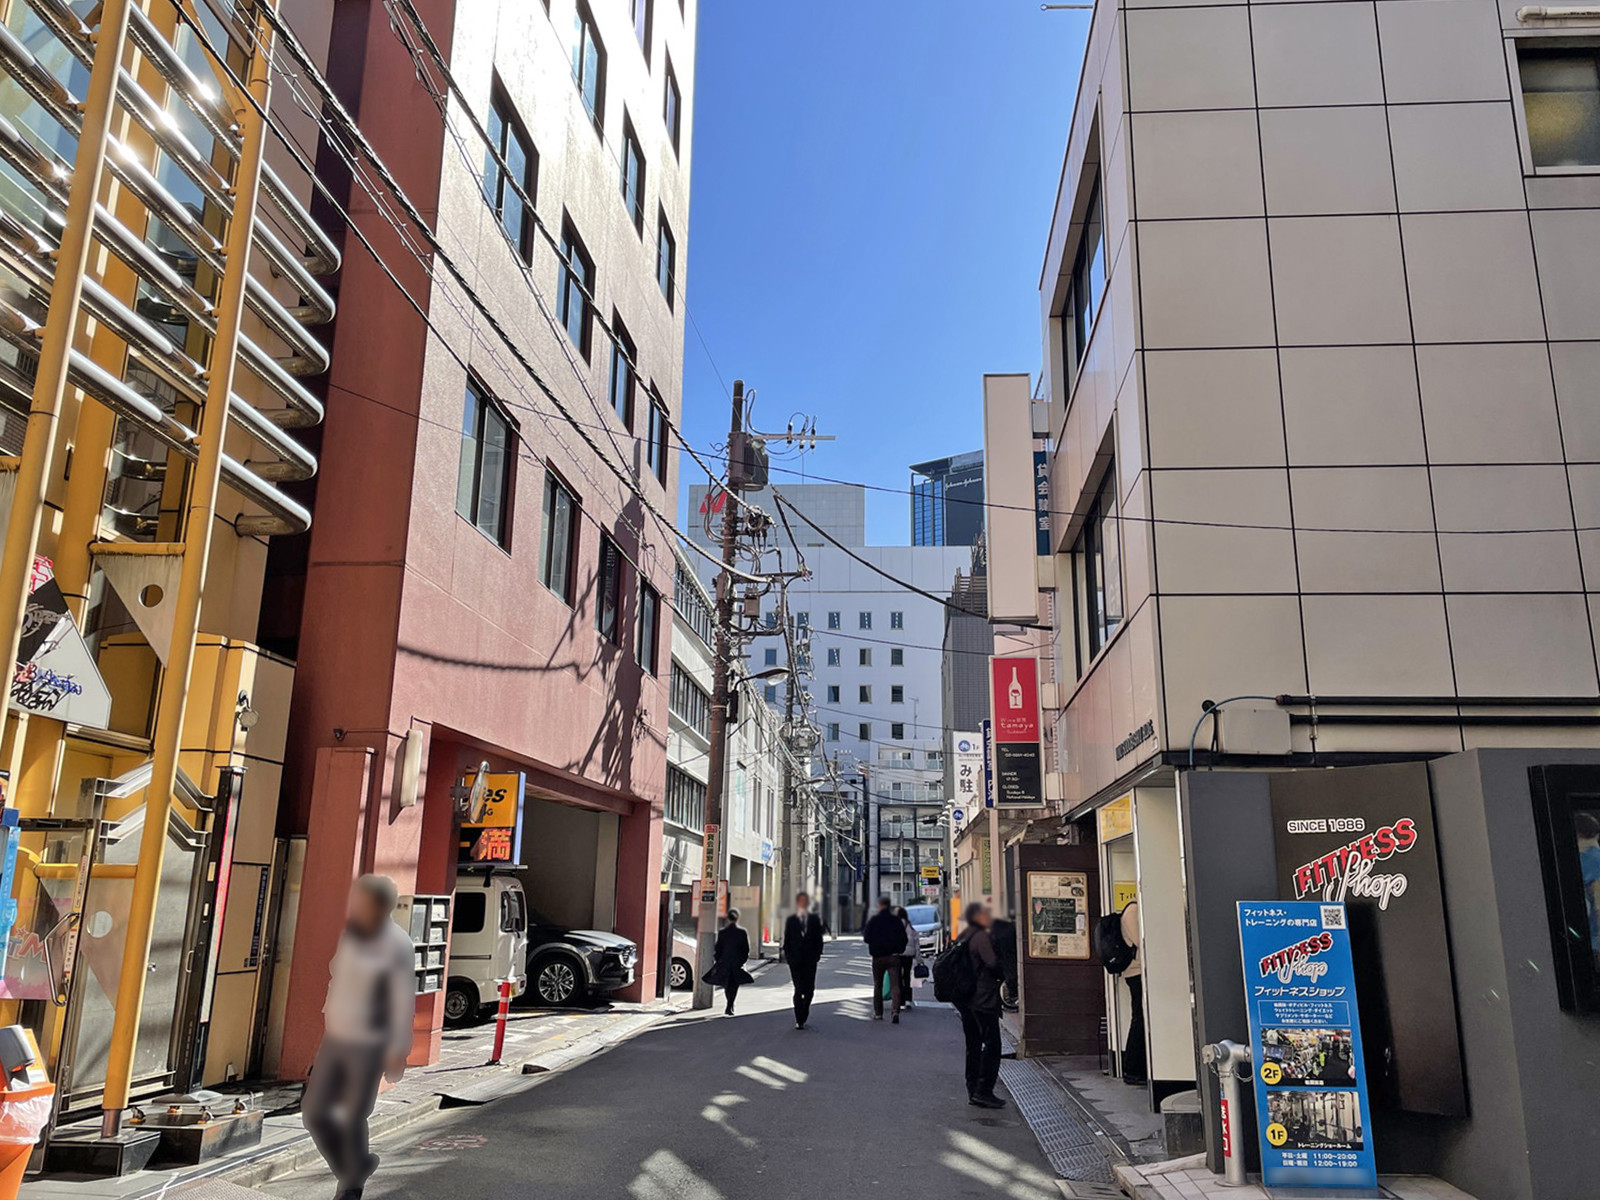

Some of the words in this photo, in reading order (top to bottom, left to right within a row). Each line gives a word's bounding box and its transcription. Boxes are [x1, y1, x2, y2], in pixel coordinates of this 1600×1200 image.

[1001, 723, 1034, 731] tamaya
[1287, 819, 1327, 833] SINCE
[1328, 818, 1366, 832] 1986
[1293, 818, 1418, 900] FITNESS
[1322, 851, 1408, 911] Shop
[1245, 918, 1318, 927] トレーニングの専門店
[1259, 931, 1333, 978] FITNESS
[1279, 949, 1329, 984] Shop
[1254, 986, 1346, 998] フィットネスショップ
[1264, 1068, 1279, 1079] 2F
[1270, 1129, 1284, 1140] 1F
